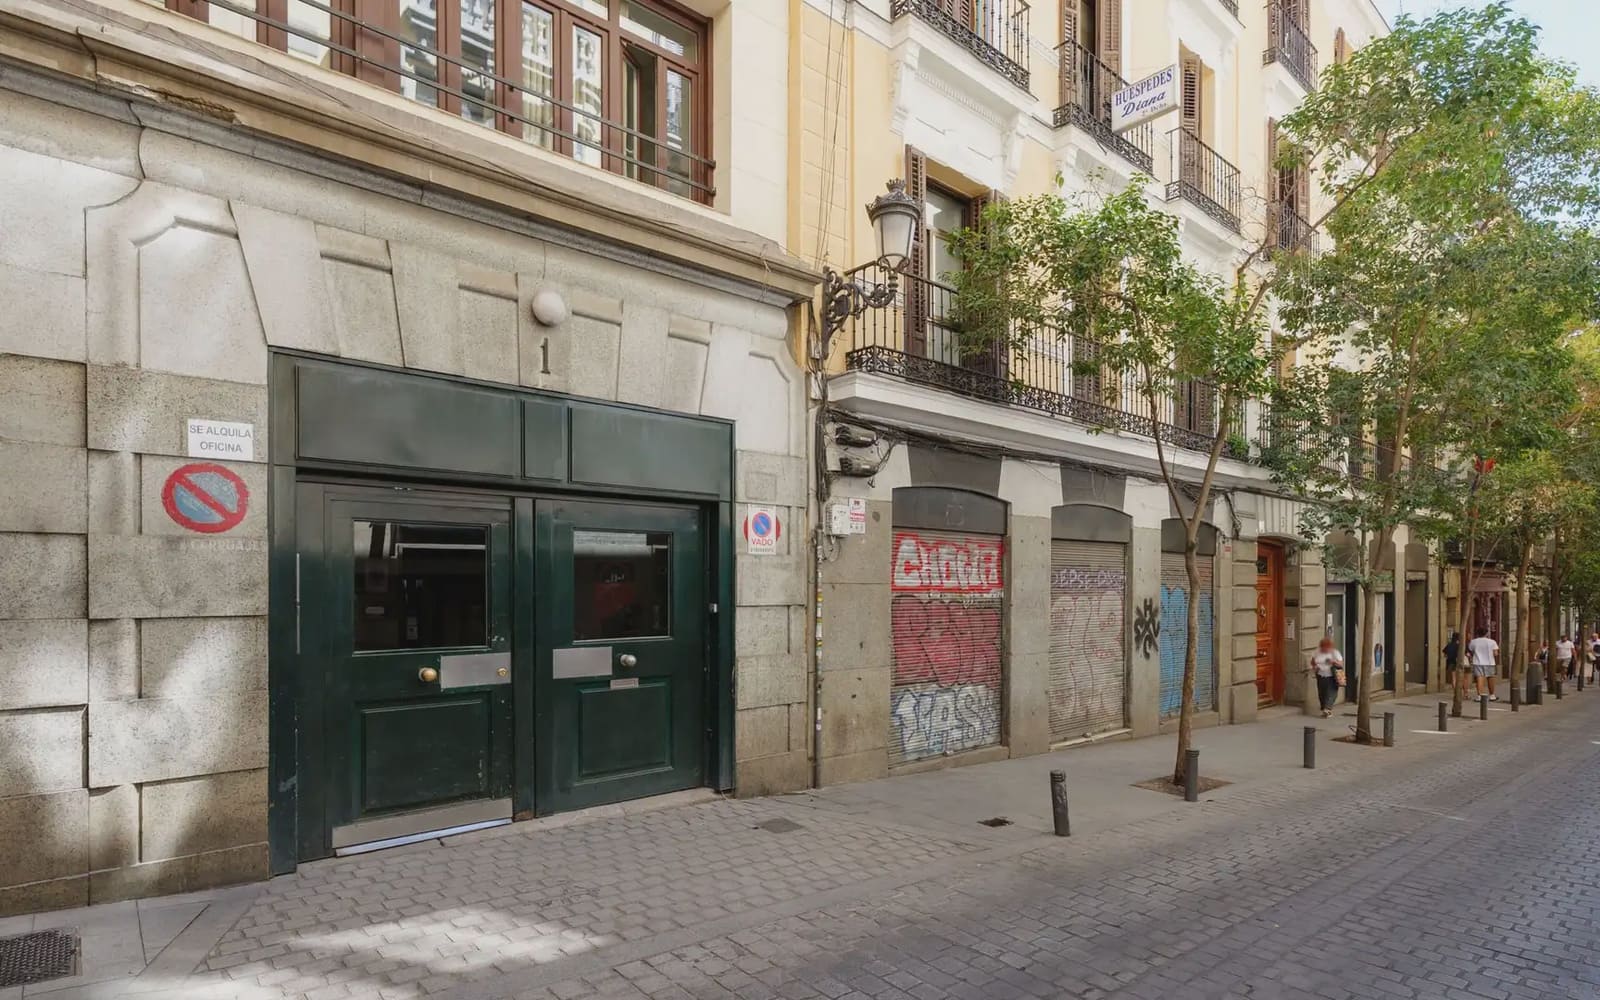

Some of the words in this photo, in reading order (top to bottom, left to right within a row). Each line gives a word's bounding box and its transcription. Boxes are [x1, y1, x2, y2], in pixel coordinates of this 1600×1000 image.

[1115, 68, 1172, 106] HUESPEDES
[1121, 91, 1166, 118] Diana
[540, 337, 551, 375] 1
[189, 425, 204, 435] SE
[206, 427, 251, 438] ALQUILA
[199, 441, 242, 453] OFICINA
[751, 538, 774, 546] VADO
